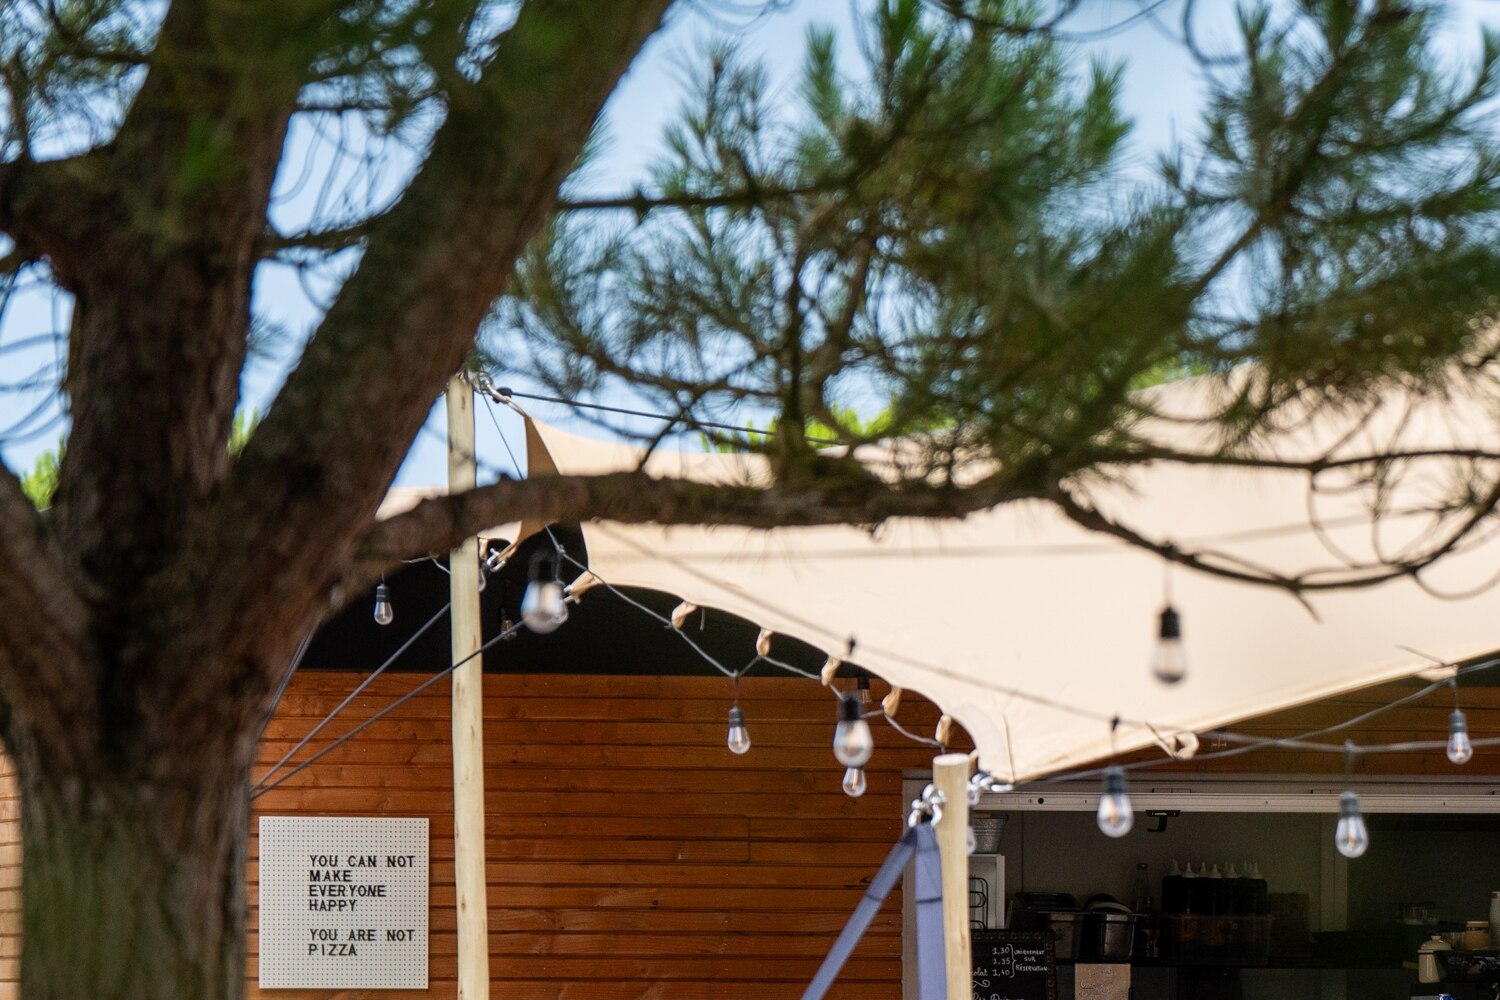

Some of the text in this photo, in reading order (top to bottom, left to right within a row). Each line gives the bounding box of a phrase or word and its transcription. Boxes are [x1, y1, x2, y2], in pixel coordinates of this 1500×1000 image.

[309, 855, 415, 867] YOU CAN NOT
[309, 869, 352, 882] MAKE
[308, 884, 387, 897] EVERYONE
[308, 899, 358, 912] HAPPY
[310, 928, 415, 942] YOU ARE NOT
[308, 943, 358, 956] PIZZA
